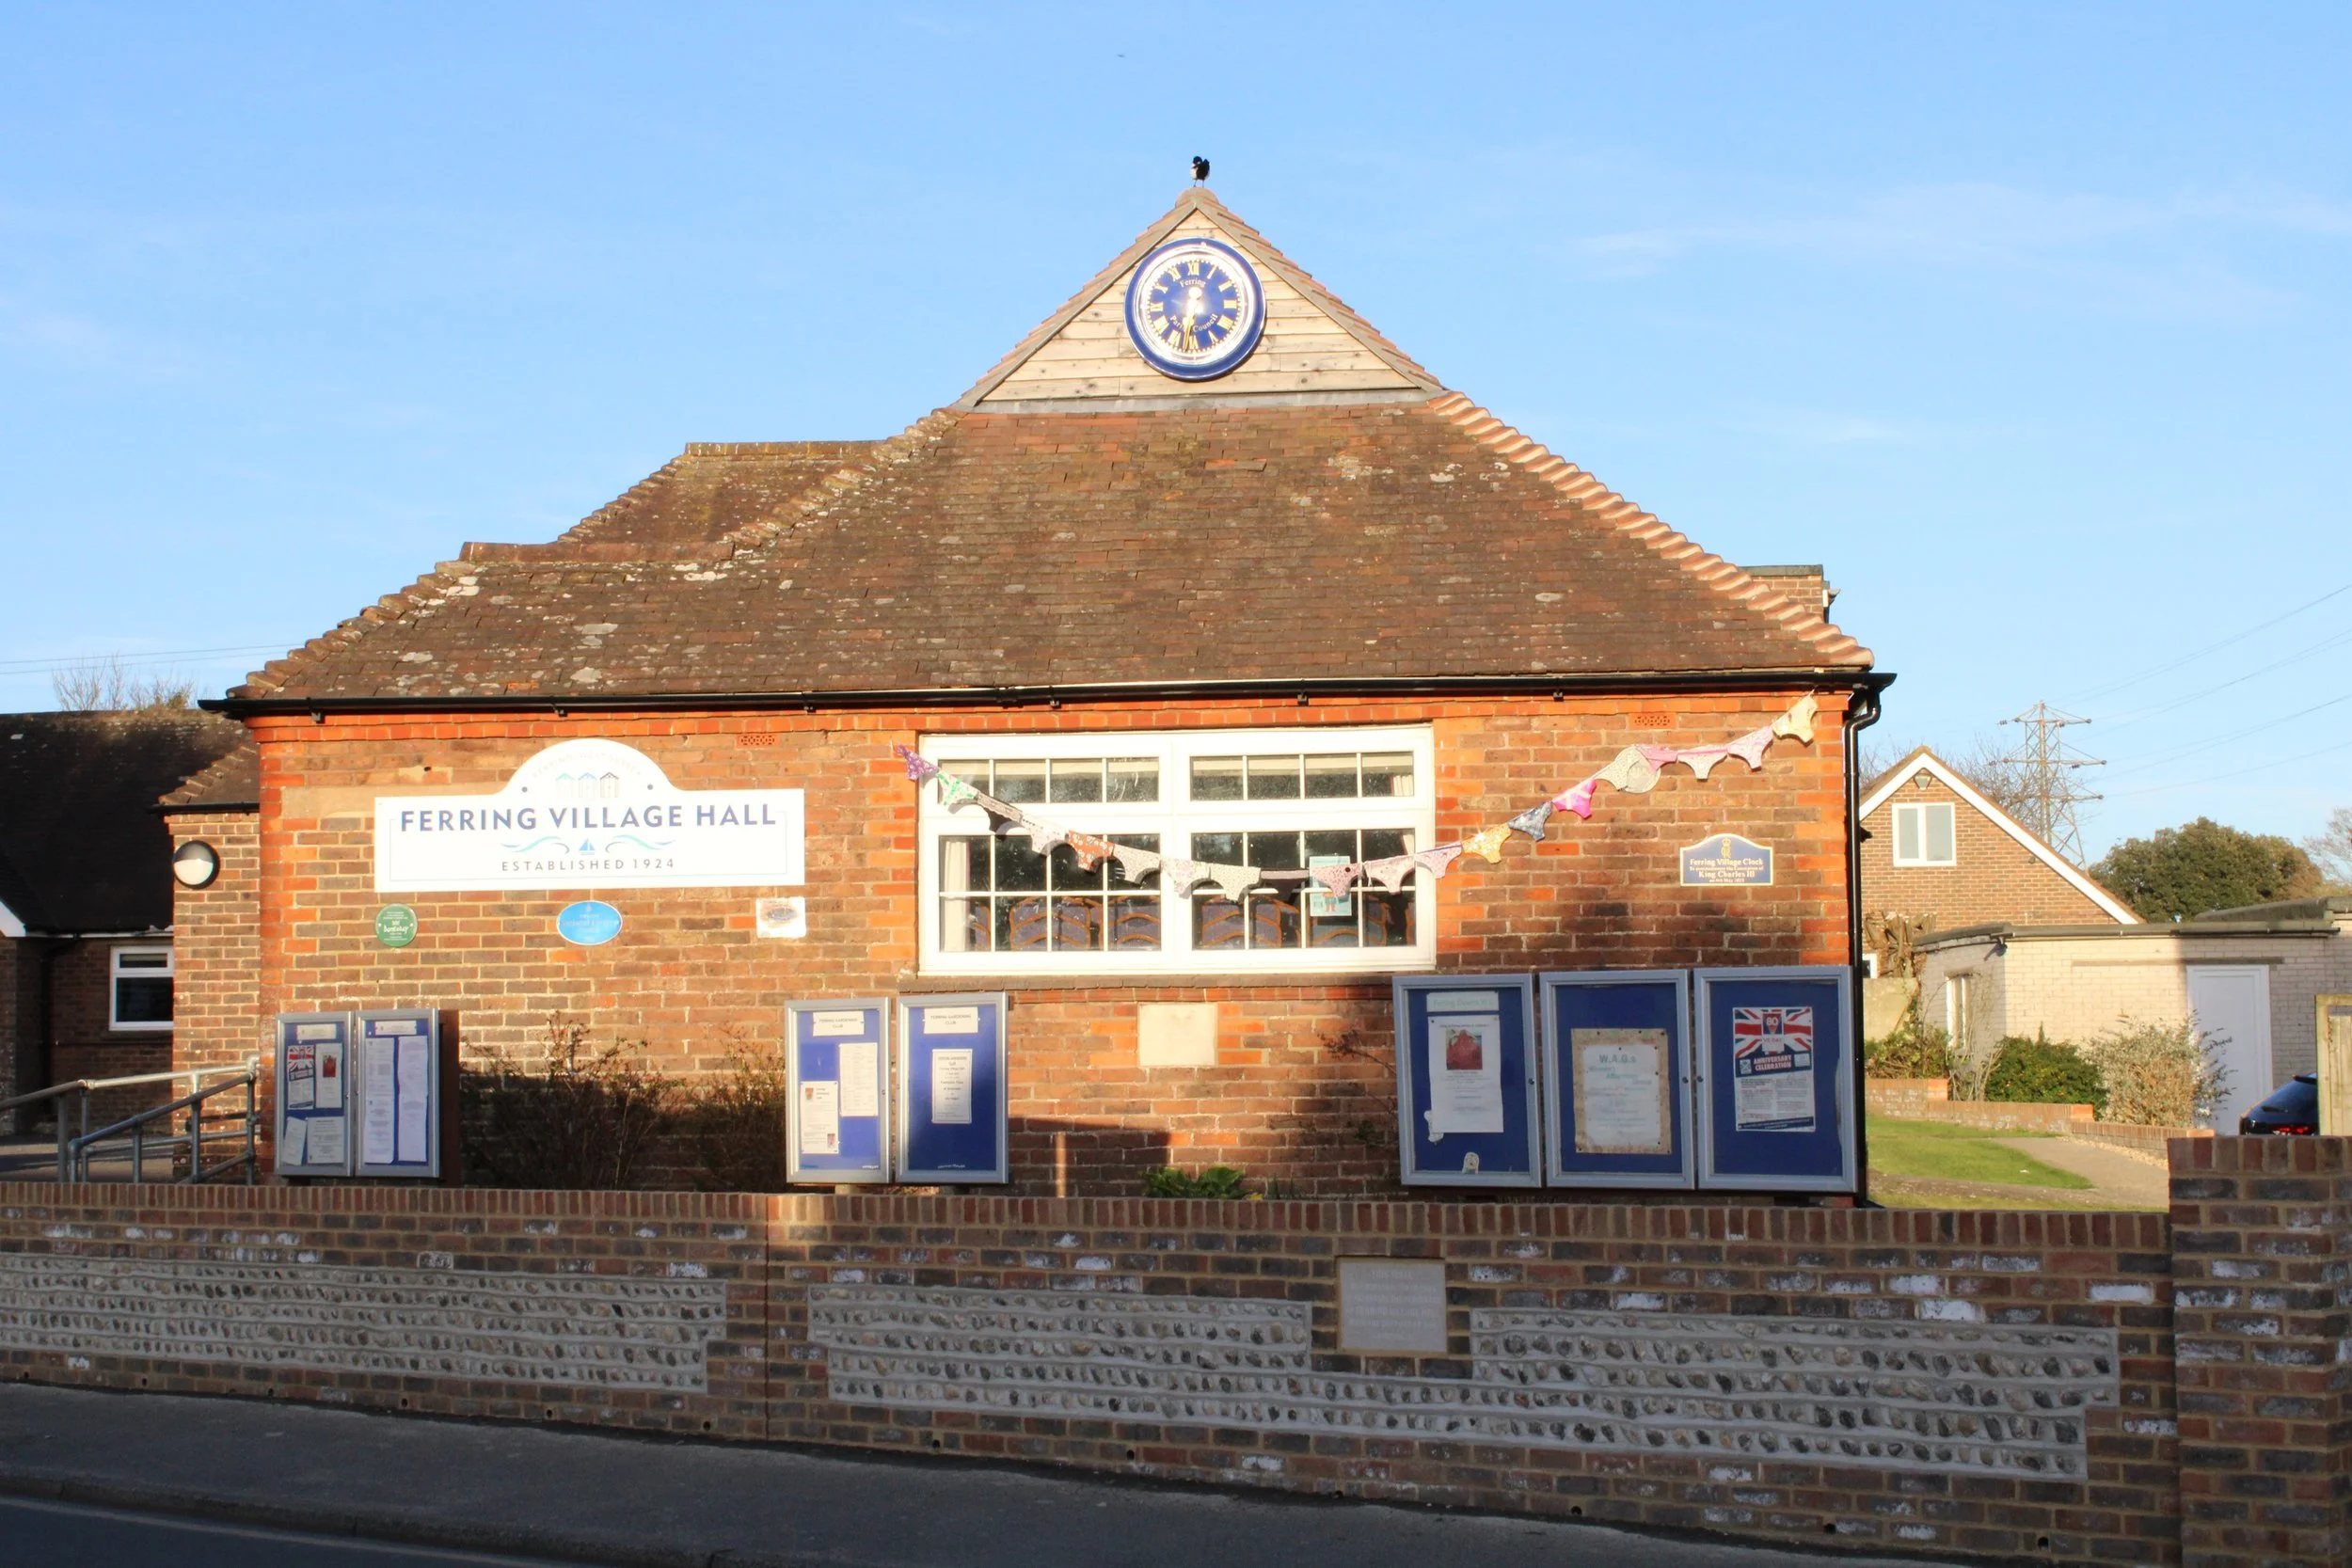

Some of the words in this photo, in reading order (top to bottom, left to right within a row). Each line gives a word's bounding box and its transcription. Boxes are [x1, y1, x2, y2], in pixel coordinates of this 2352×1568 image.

[1179, 278, 1206, 288] Ferring
[1192, 313, 1218, 332] Council
[400, 807, 537, 832] FERRING
[548, 804, 683, 829] VILLAGE
[696, 802, 776, 826] HALL
[501, 859, 625, 872] ESTABLISHED
[632, 858, 675, 870] 1924
[1690, 858, 1716, 866] Ferring
[1716, 858, 1741, 866] Village
[1766, 1017, 1779, 1025] 80
[1753, 1054, 1792, 1065] ANNIVERSARY
[1755, 1061, 1792, 1071] CELEBRATION
